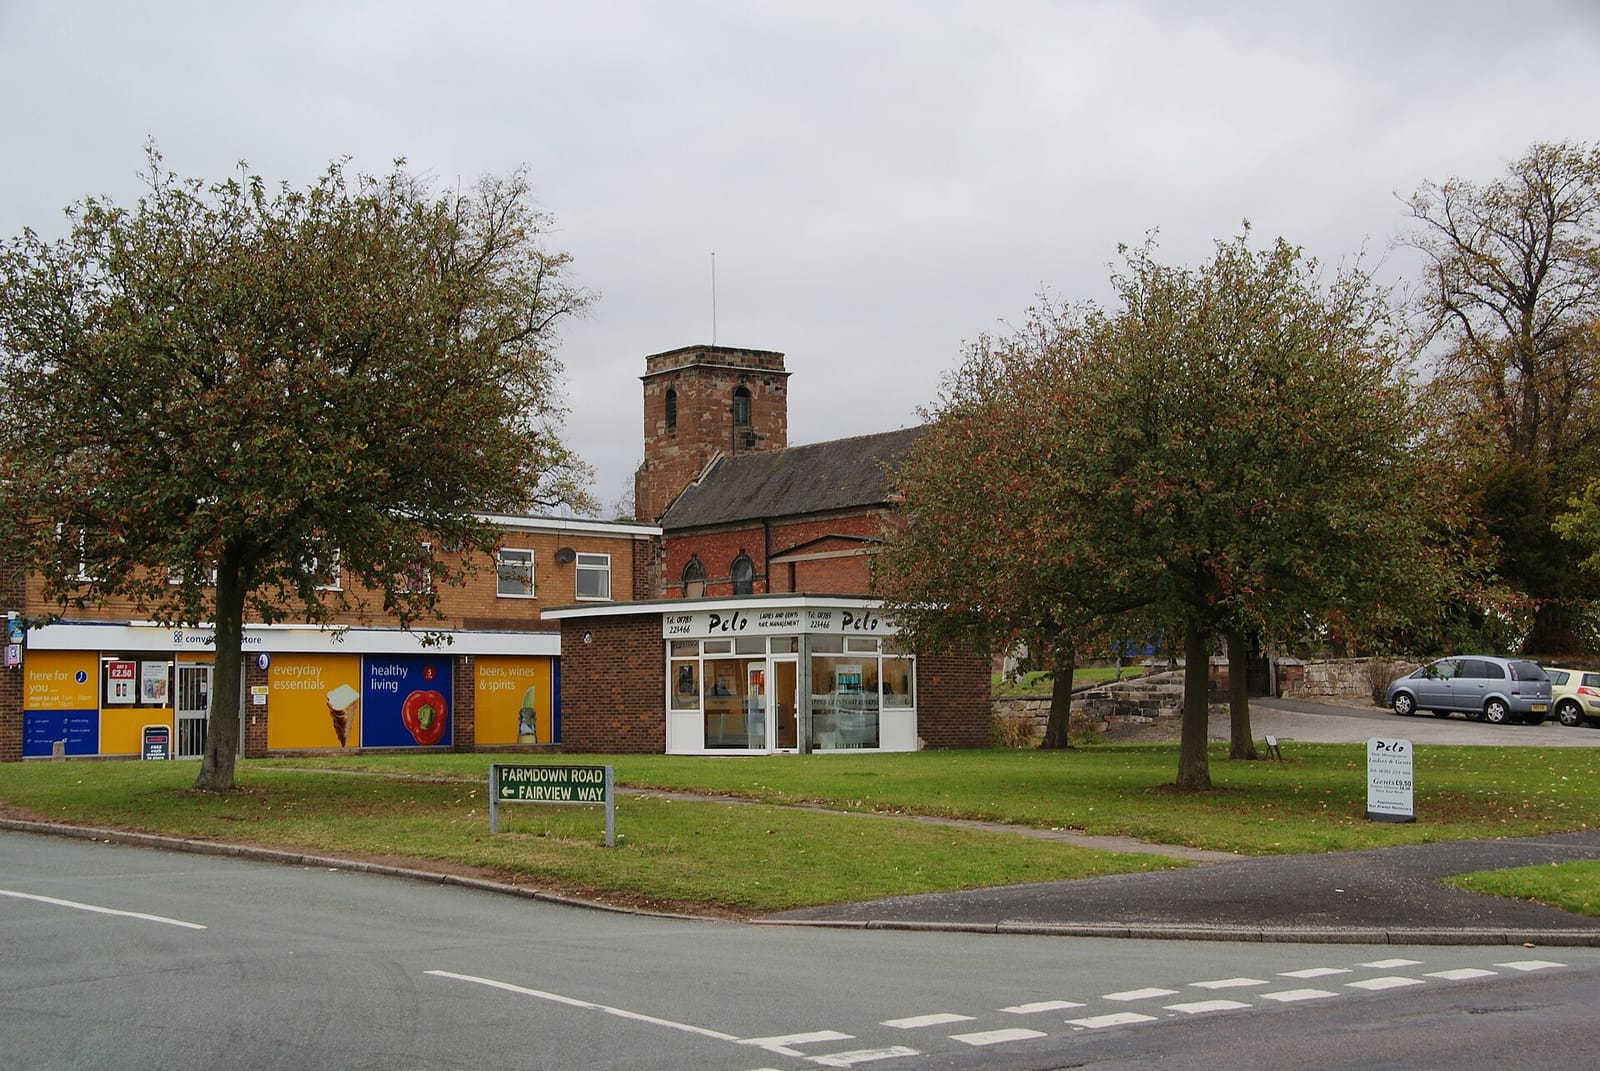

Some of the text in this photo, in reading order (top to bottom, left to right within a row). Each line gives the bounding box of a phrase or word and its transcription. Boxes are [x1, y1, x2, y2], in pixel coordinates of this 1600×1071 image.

[708, 611, 748, 634] Pelo
[842, 610, 878, 631] Pelo
[30, 670, 69, 680] here for
[273, 664, 322, 677] everyday
[371, 664, 408, 678] healthy
[480, 665, 535, 677] beers, wines
[29, 684, 49, 695] you
[273, 679, 325, 690] essentials
[371, 679, 399, 693] living
[480, 680, 516, 692] & spirits
[1376, 741, 1404, 752] Pelo
[502, 768, 603, 784] FARMDOWN ROAD
[519, 786, 604, 800] FAIRVIEW WAY
